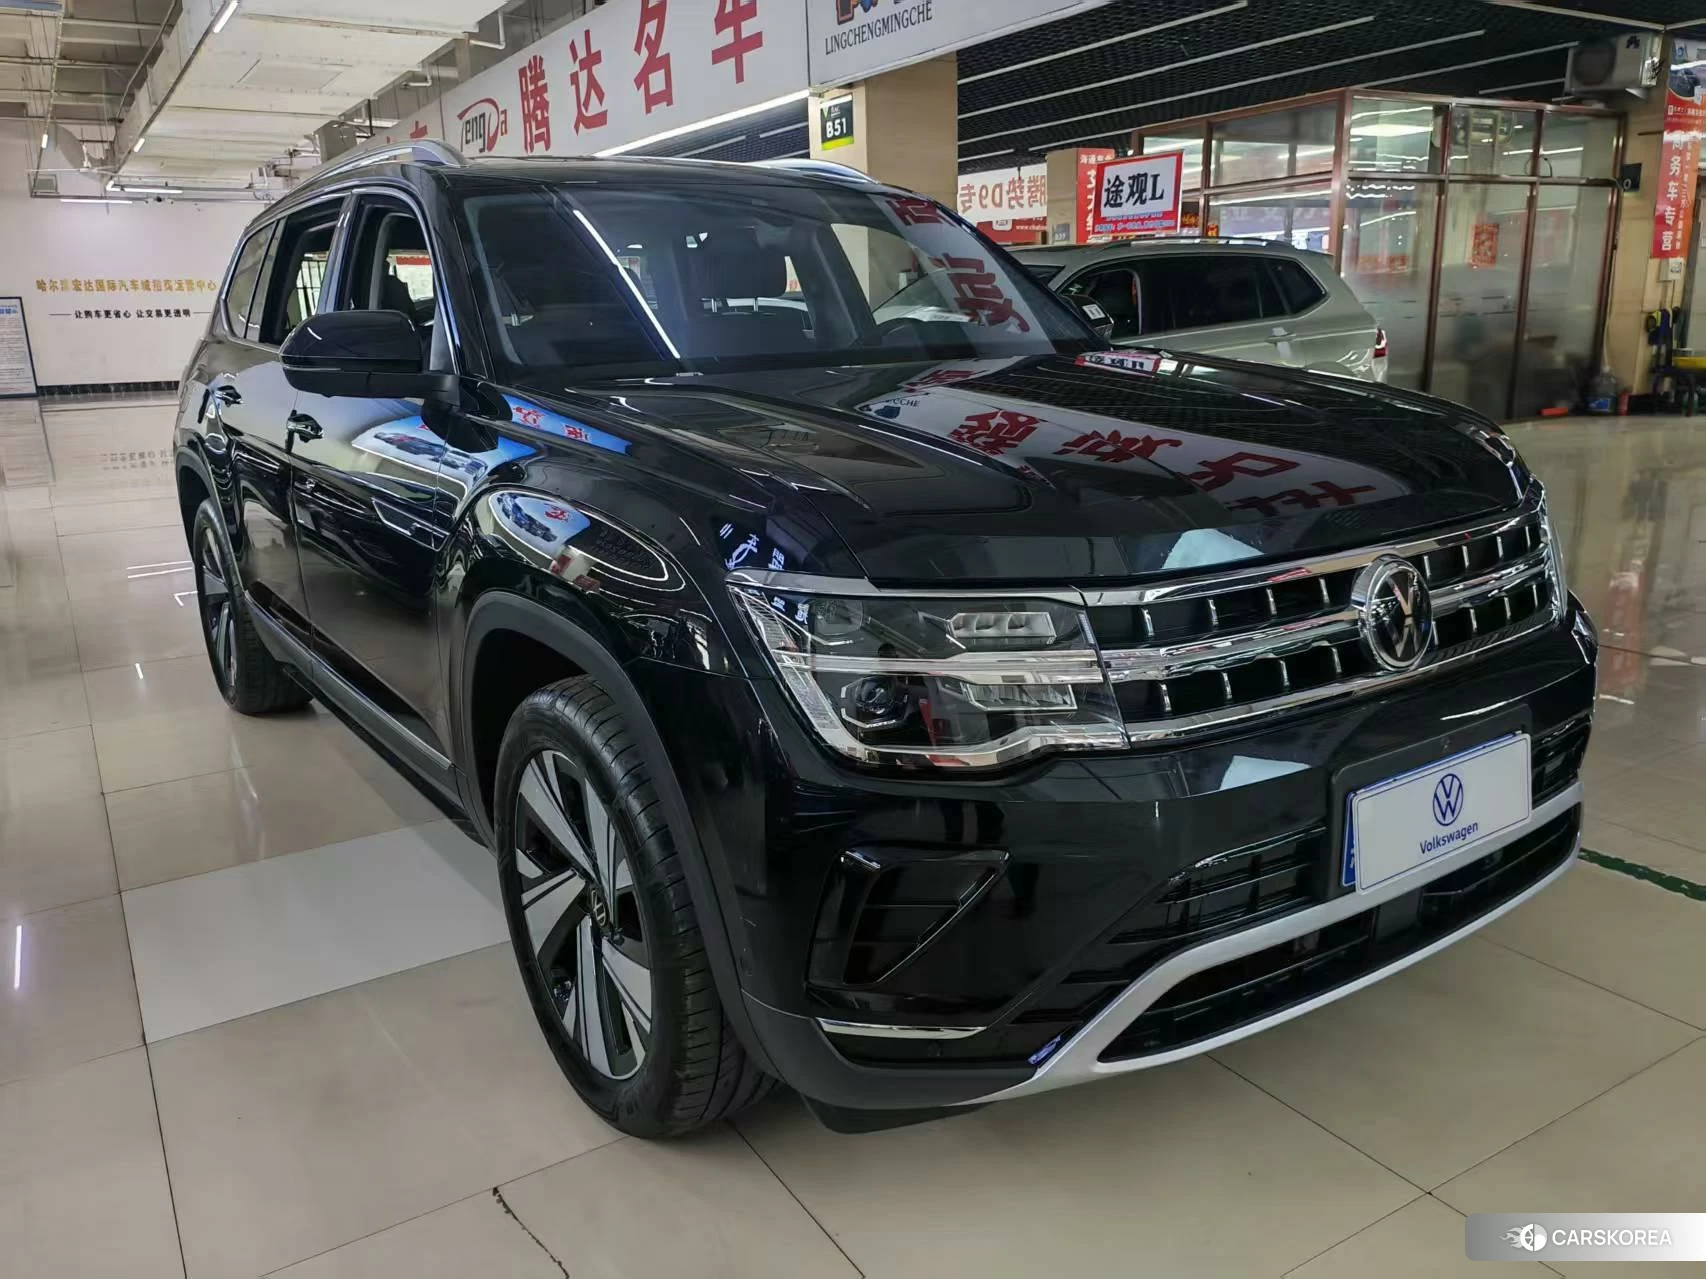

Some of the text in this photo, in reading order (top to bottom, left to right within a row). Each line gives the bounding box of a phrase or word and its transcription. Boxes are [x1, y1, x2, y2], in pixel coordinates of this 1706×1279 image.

[825, 1, 933, 55] LINGCHENGMINGCHE
[517, 0, 763, 154] 腾达名车
[826, 117, 847, 138] B51
[1104, 172, 1165, 208] 途观L
[74, 308, 192, 320] 让购车更省心 让交易更透明
[1420, 822, 1479, 854] Volkswagen
